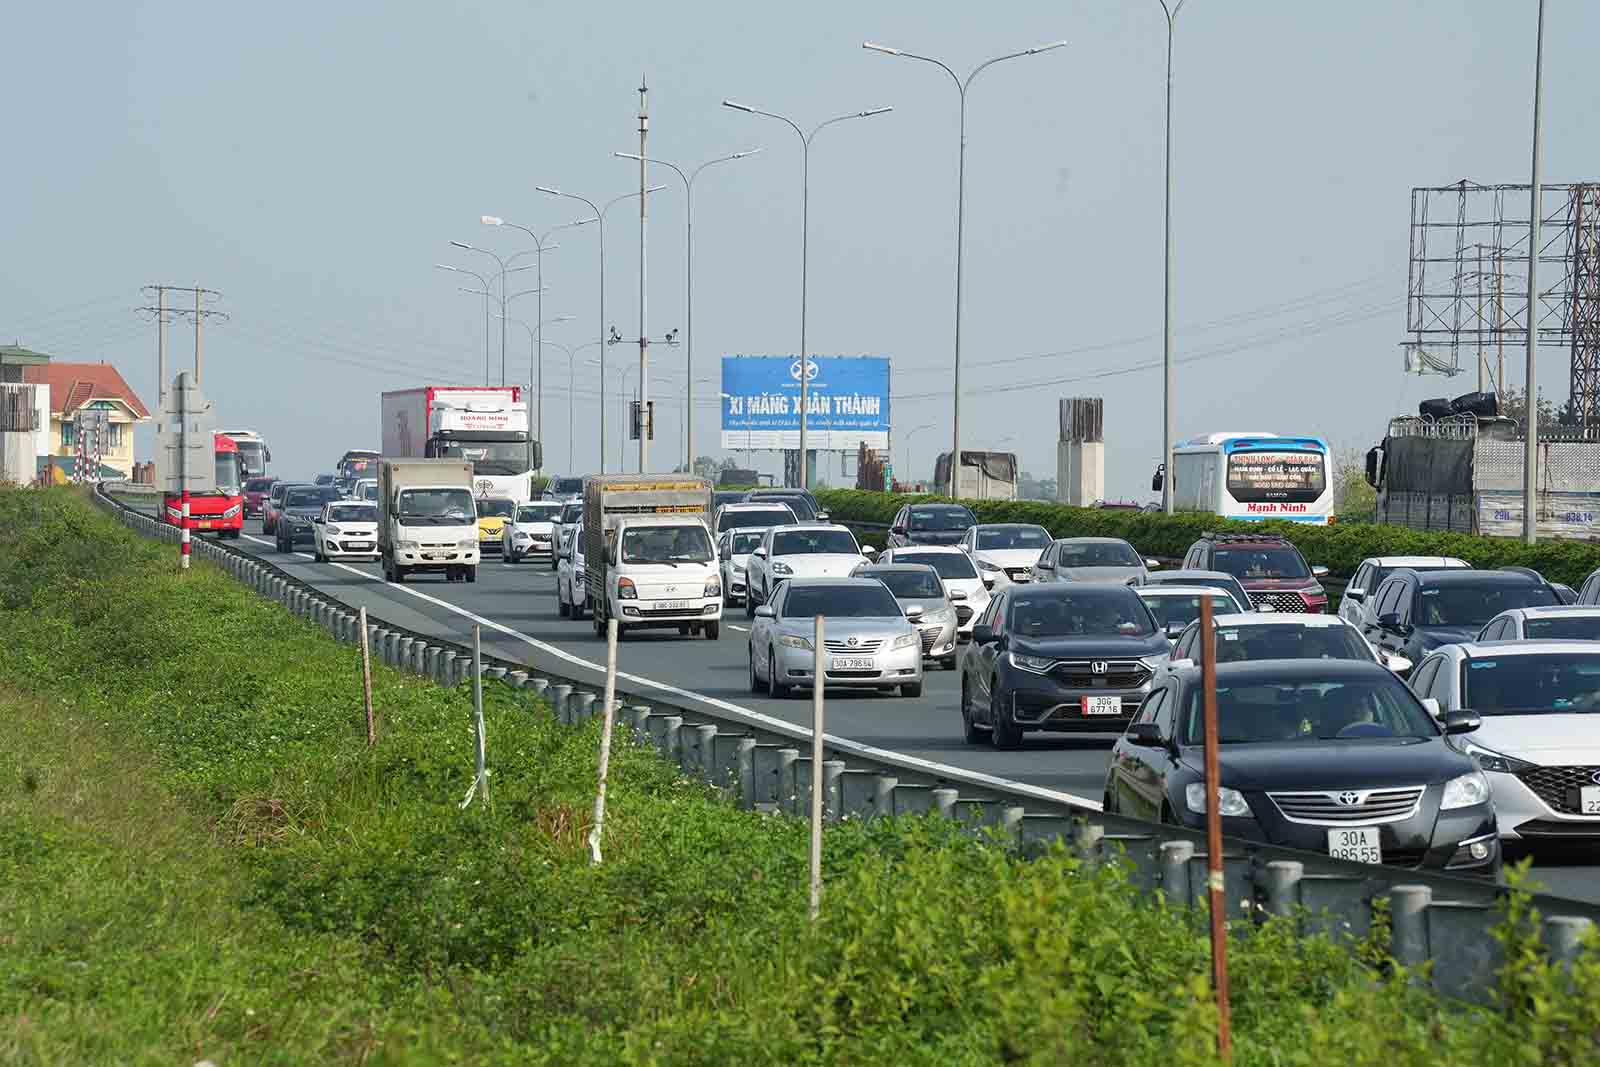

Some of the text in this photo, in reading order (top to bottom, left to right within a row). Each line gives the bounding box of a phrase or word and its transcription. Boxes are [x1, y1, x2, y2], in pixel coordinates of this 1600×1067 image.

[729, 396, 743, 415] XI
[747, 391, 789, 415] MĂNG
[833, 391, 880, 415] THÀNH
[1280, 503, 1307, 512] Ninh
[1096, 697, 1112, 706] 30G
[1341, 831, 1367, 847] 30A
